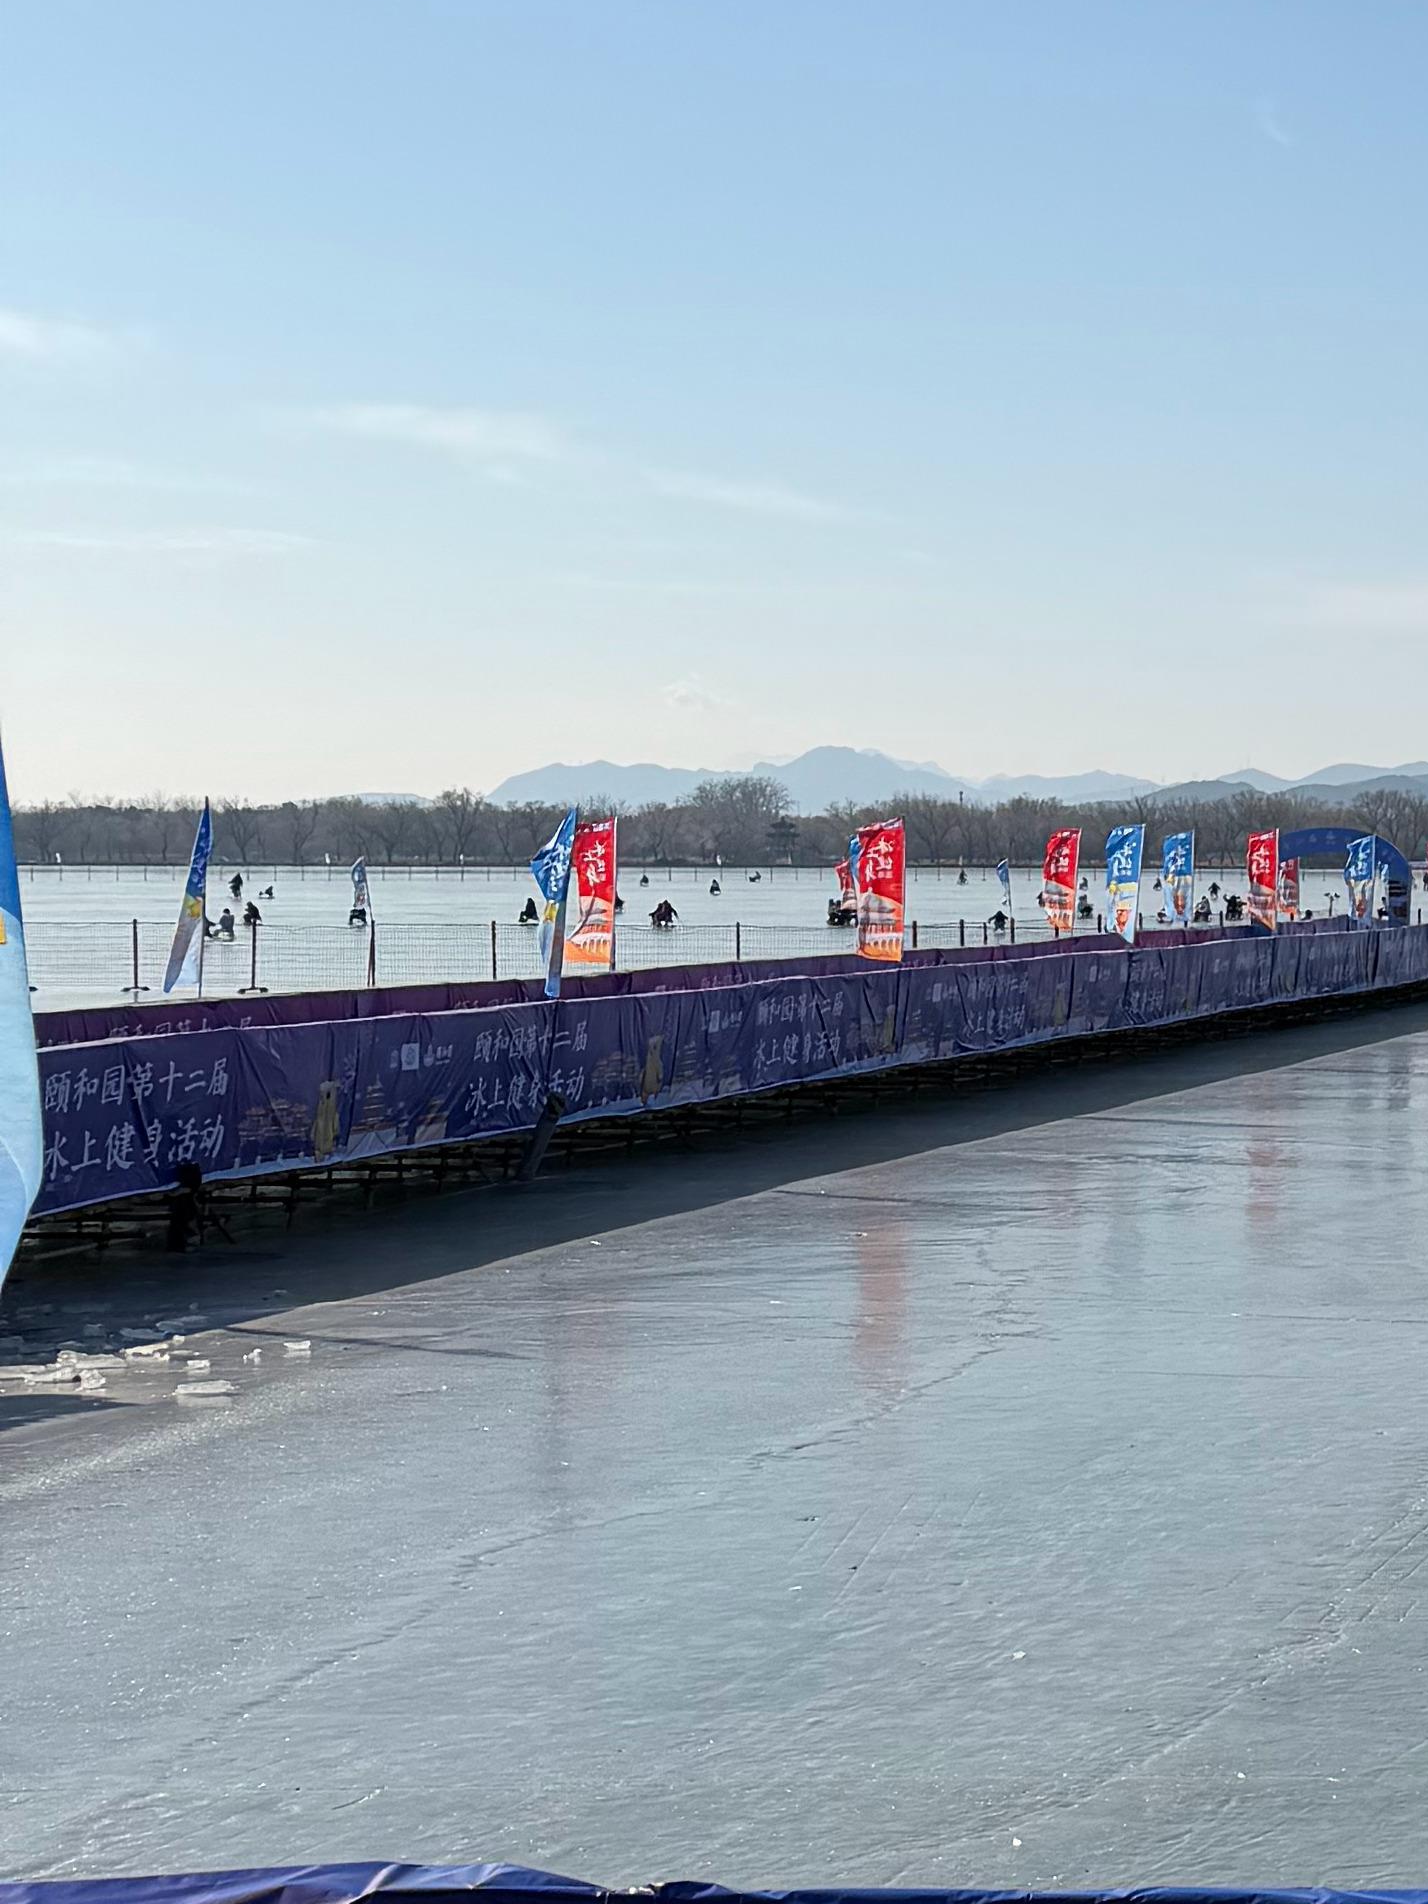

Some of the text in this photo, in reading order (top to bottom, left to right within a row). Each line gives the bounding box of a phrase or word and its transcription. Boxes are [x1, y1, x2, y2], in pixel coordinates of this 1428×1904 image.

[45, 1057, 229, 1113] 颐和园第十二届
